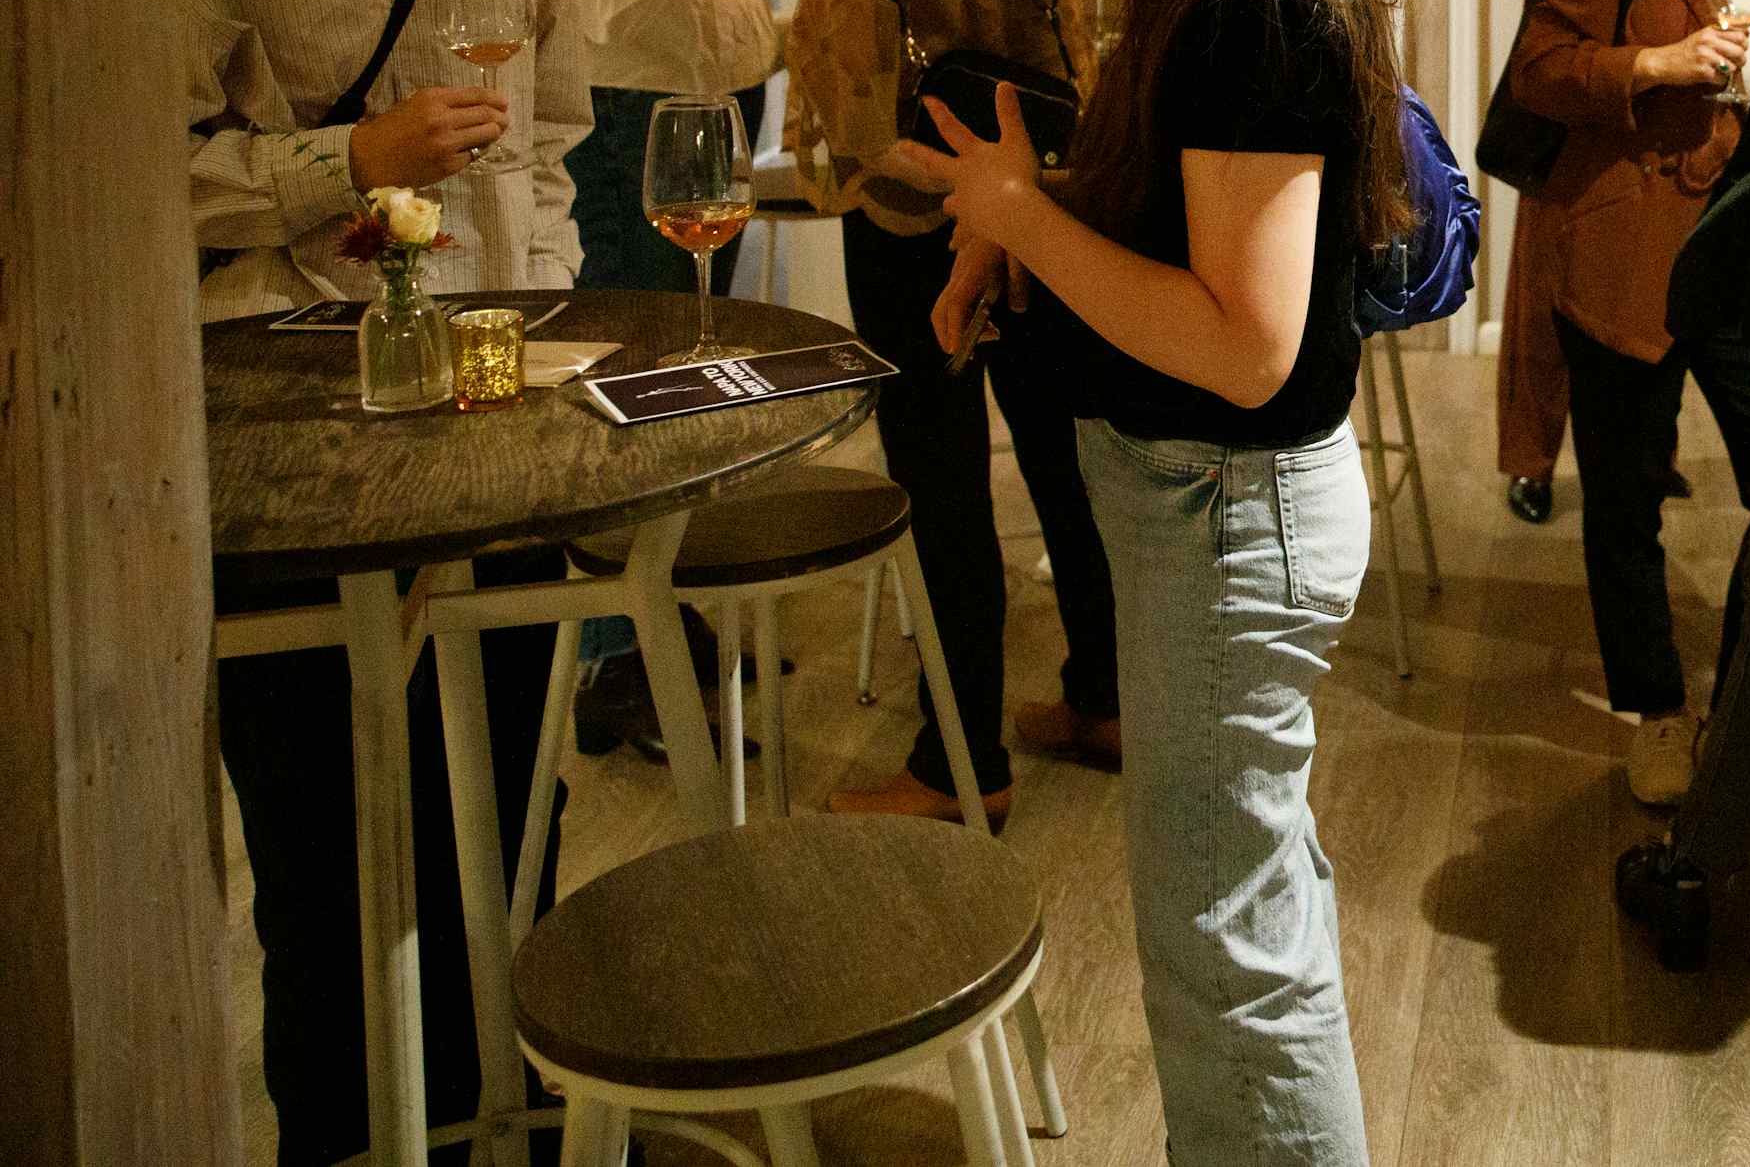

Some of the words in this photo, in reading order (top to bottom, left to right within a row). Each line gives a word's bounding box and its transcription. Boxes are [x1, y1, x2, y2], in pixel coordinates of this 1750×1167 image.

[702, 367, 723, 379] TO
[719, 361, 750, 382] YORK
[712, 376, 745, 397] NAPA
[737, 379, 769, 396] NEW
